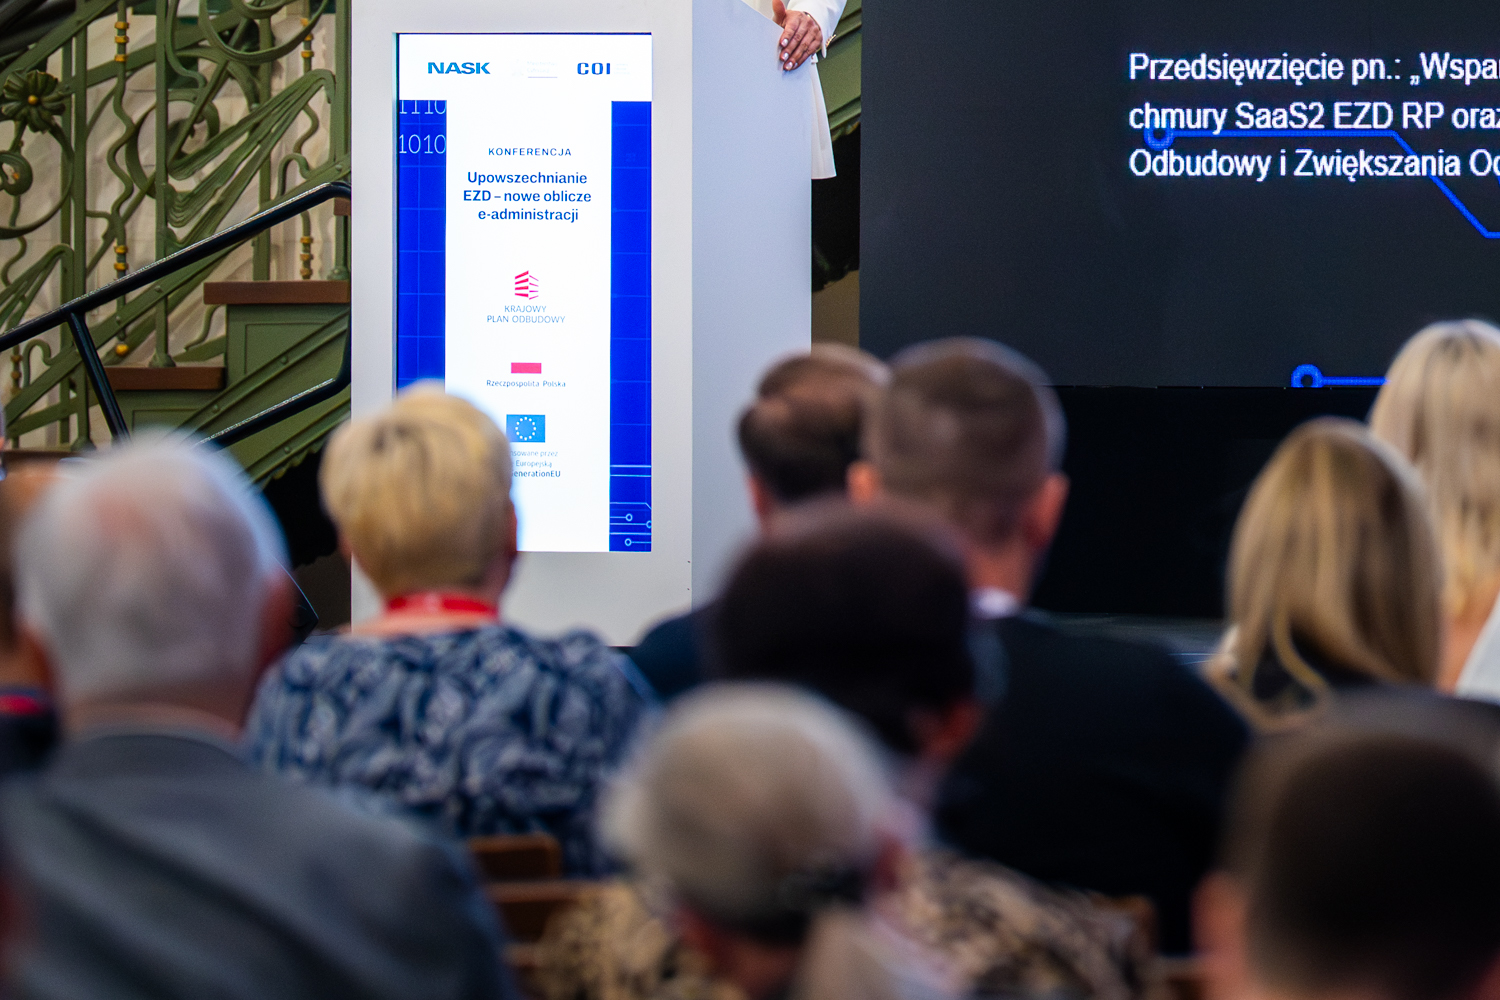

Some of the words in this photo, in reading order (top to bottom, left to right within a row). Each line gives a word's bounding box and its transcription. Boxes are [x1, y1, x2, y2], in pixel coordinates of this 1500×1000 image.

[427, 61, 491, 75] NASK
[1130, 51, 1344, 86] Przedsięwzięcie
[1351, 58, 1401, 86] pn.:
[1128, 102, 1228, 136] chmury
[1235, 101, 1325, 129] SaaS2
[1333, 101, 1394, 129] EZD
[1402, 101, 1445, 129] RP
[488, 147, 572, 157] KONFERENCJA
[1129, 148, 1272, 182] Odbudowy
[1280, 148, 1286, 176] i
[1293, 148, 1461, 182] Zwiększania
[467, 171, 588, 185] Upowszechnianie
[463, 190, 492, 202] EZD
[504, 192, 541, 202] nowe
[543, 189, 592, 203] oblicze
[477, 208, 579, 223] e-administracji
[504, 304, 547, 314] KRAJOWY
[486, 314, 509, 324] PLAN
[512, 314, 566, 324] ODBUDOWY
[486, 379, 540, 389] Rzeczpospolita
[543, 379, 566, 388] Polska
